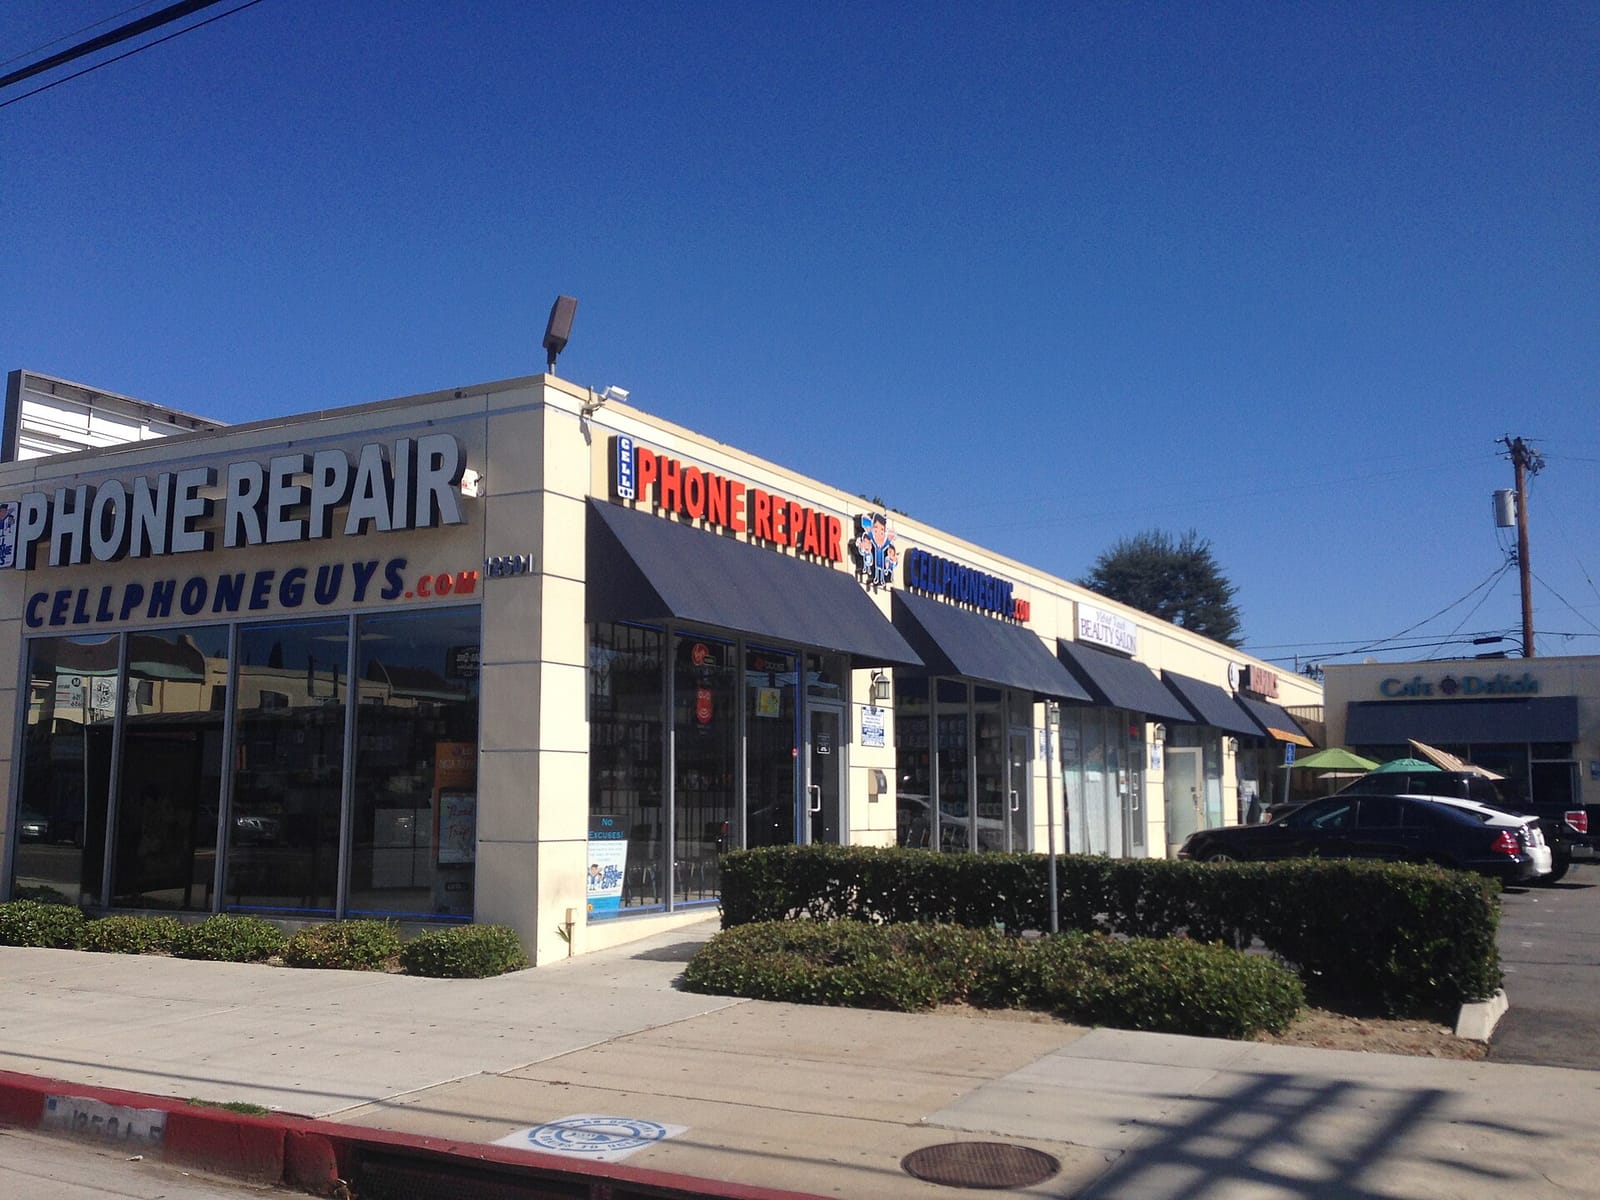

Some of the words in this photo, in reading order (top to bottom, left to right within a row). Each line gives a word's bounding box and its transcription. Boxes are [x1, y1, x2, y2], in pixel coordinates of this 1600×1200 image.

[620, 438, 631, 488] CELL
[16, 467, 215, 570] PHONE
[224, 434, 467, 548] REPAIR
[636, 446, 747, 533] PHONE
[752, 487, 844, 563] REPAIR
[1081, 618, 1114, 644] BEAUTY
[1115, 629, 1137, 653] SALON
[601, 817, 614, 827] No
